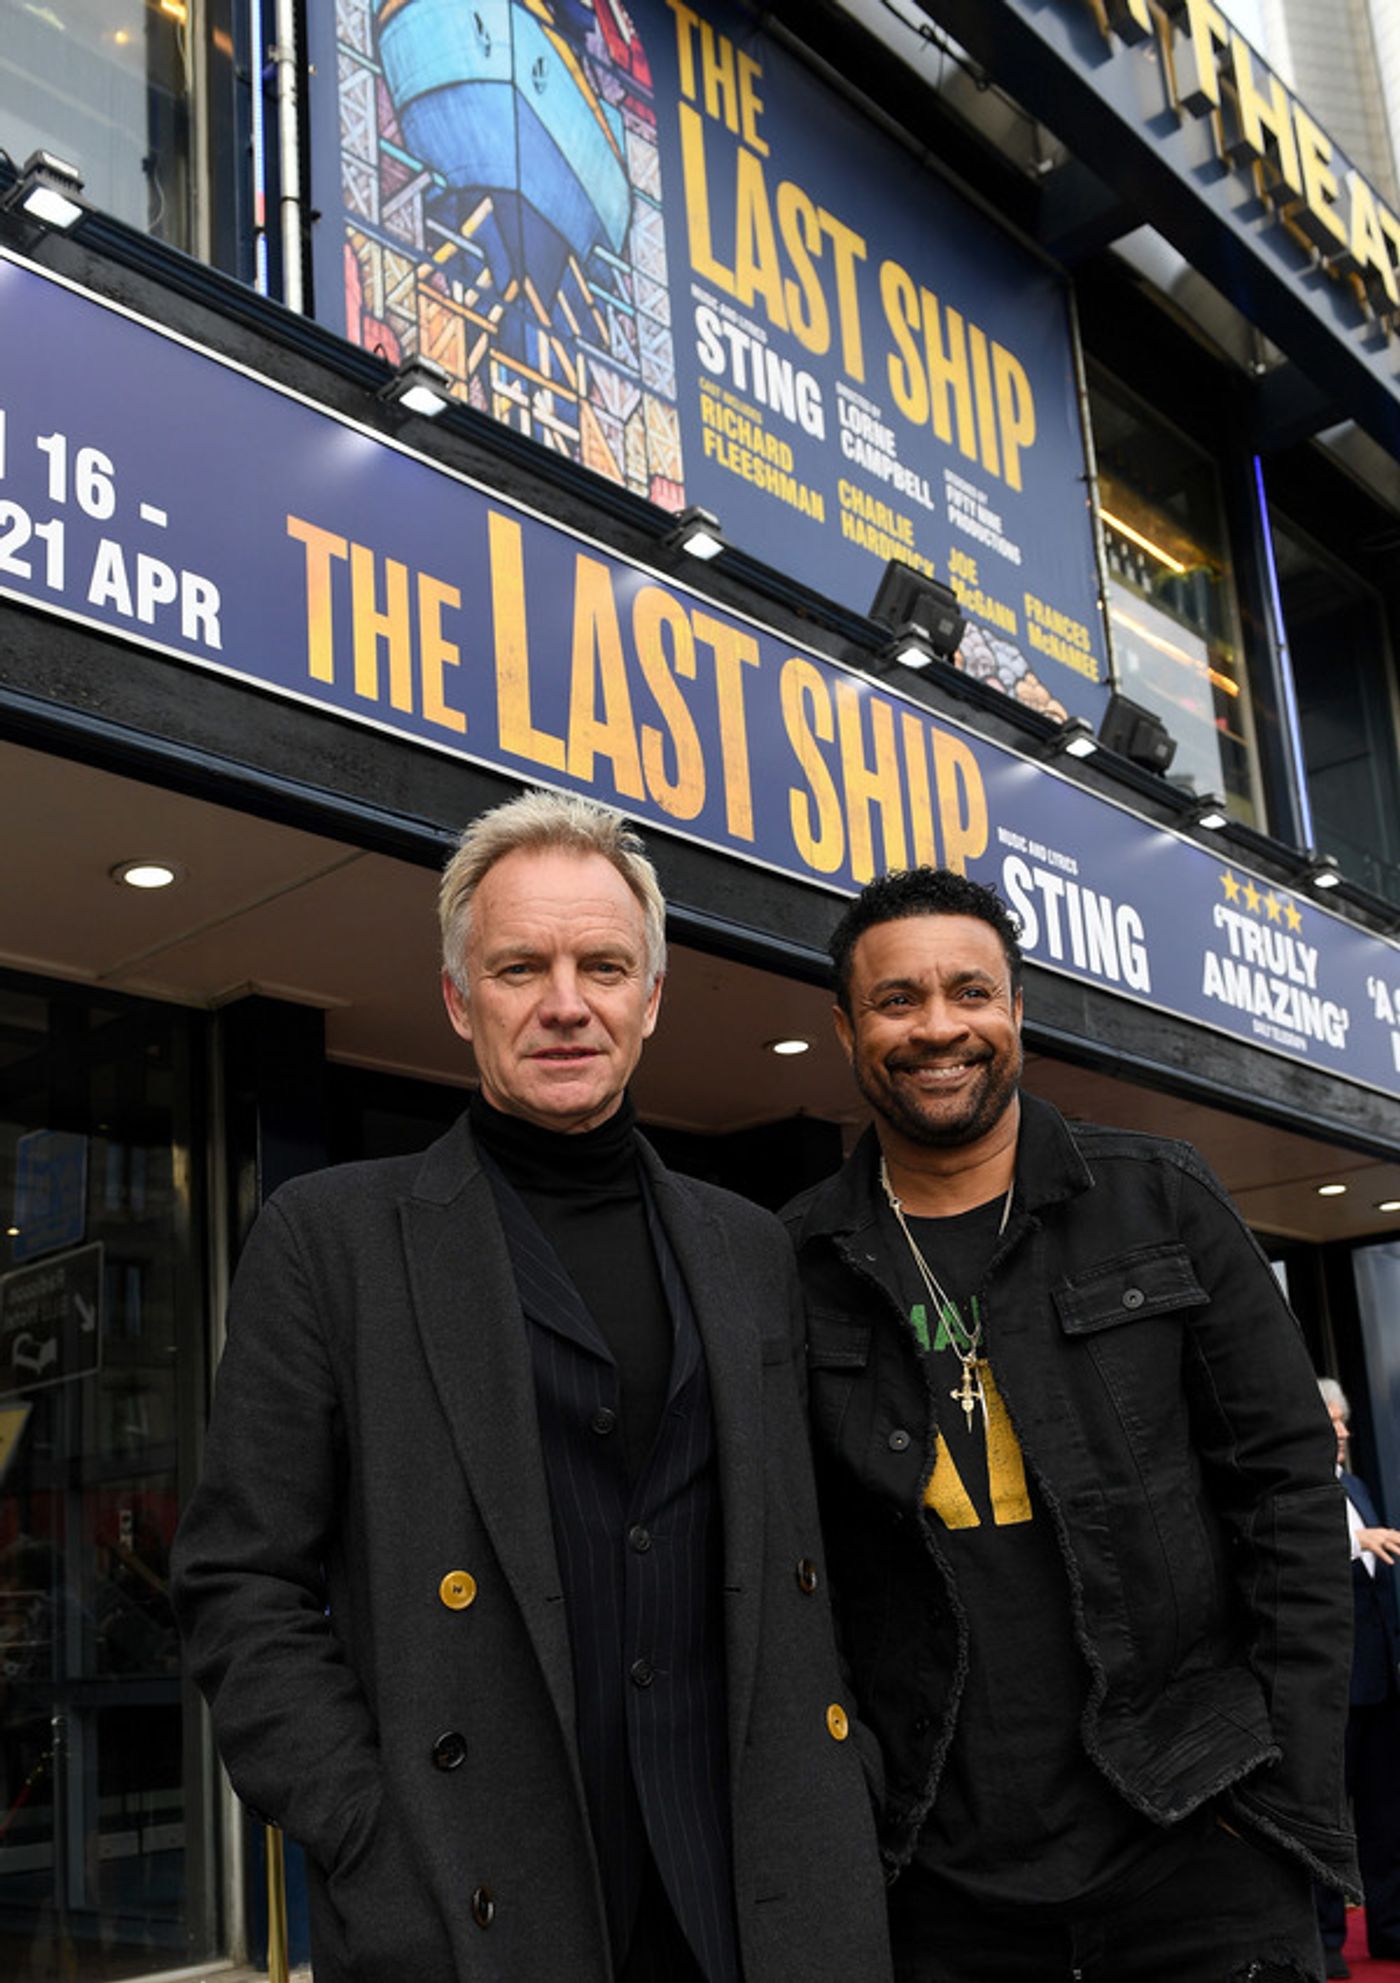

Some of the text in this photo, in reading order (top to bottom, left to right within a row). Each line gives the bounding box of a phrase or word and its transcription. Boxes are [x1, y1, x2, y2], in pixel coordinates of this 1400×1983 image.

[665, 0, 769, 157] THE
[679, 100, 1036, 492] LAST SHIP
[695, 305, 825, 439] STING
[700, 393, 793, 473] RICHARD
[703, 426, 825, 523] FLEESHMAN
[838, 396, 897, 458] LORNE
[840, 430, 934, 511] CAMPBELL
[37, 432, 116, 520] 16
[140, 502, 168, 529] -
[838, 479, 915, 548] CHARLIE
[0, 499, 223, 650] 21 APR
[948, 547, 978, 585] JOE
[1024, 592, 1091, 653] FRANCES
[286, 509, 990, 884] THE LAST SHIP
[1002, 855, 1151, 993] STING
